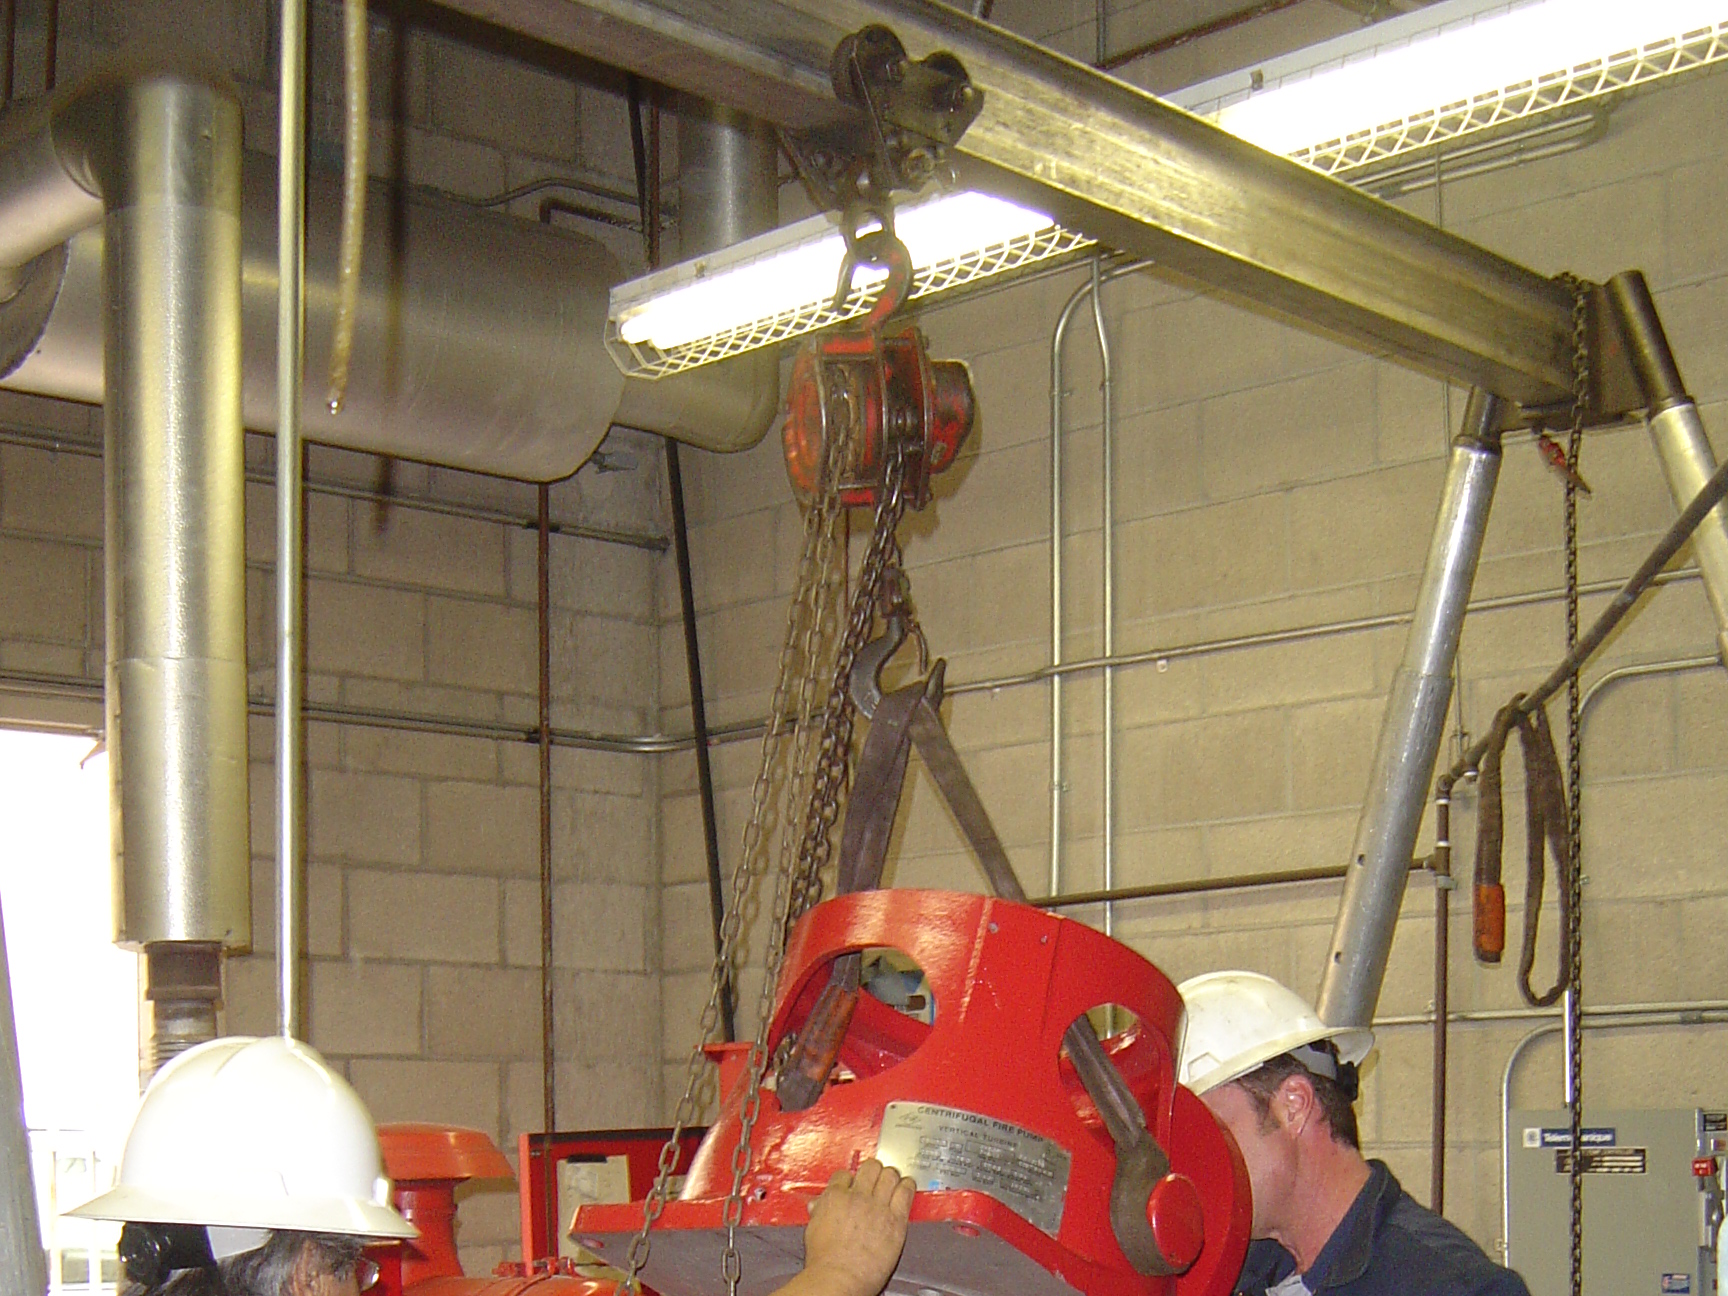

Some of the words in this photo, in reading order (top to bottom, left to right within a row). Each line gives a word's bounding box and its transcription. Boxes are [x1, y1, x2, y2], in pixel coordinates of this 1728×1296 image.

[917, 1106, 990, 1127] CENTRIFUGAL
[992, 1120, 1015, 1134] FIRE
[1017, 1127, 1044, 1143] PUMP
[939, 1125, 979, 1139] VERTICAL
[983, 1133, 1018, 1148] TURBINE
